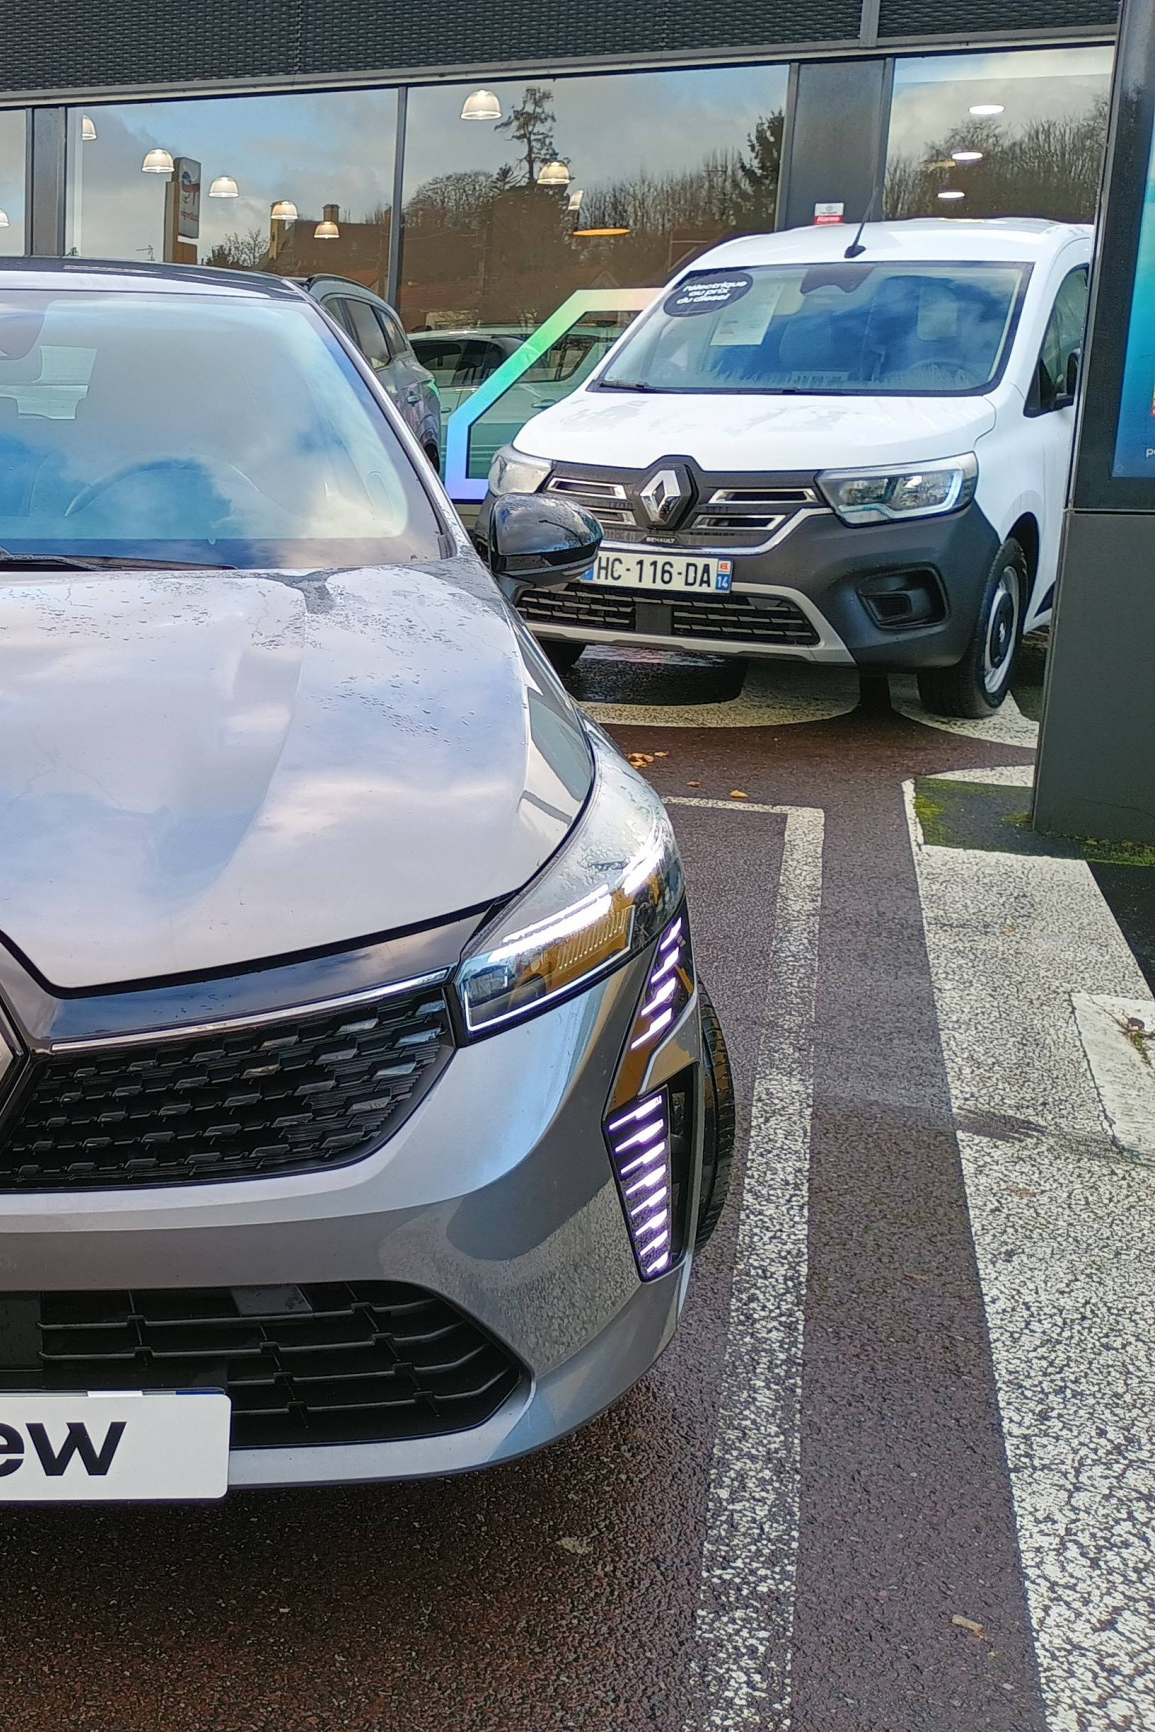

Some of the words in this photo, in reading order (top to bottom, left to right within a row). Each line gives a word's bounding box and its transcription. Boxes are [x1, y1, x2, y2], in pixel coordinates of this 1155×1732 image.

[693, 293, 732, 303] diesel
[705, 288, 731, 297] prix
[597, 556, 711, 588] HC-116-DA
[717, 576, 729, 588] 14
